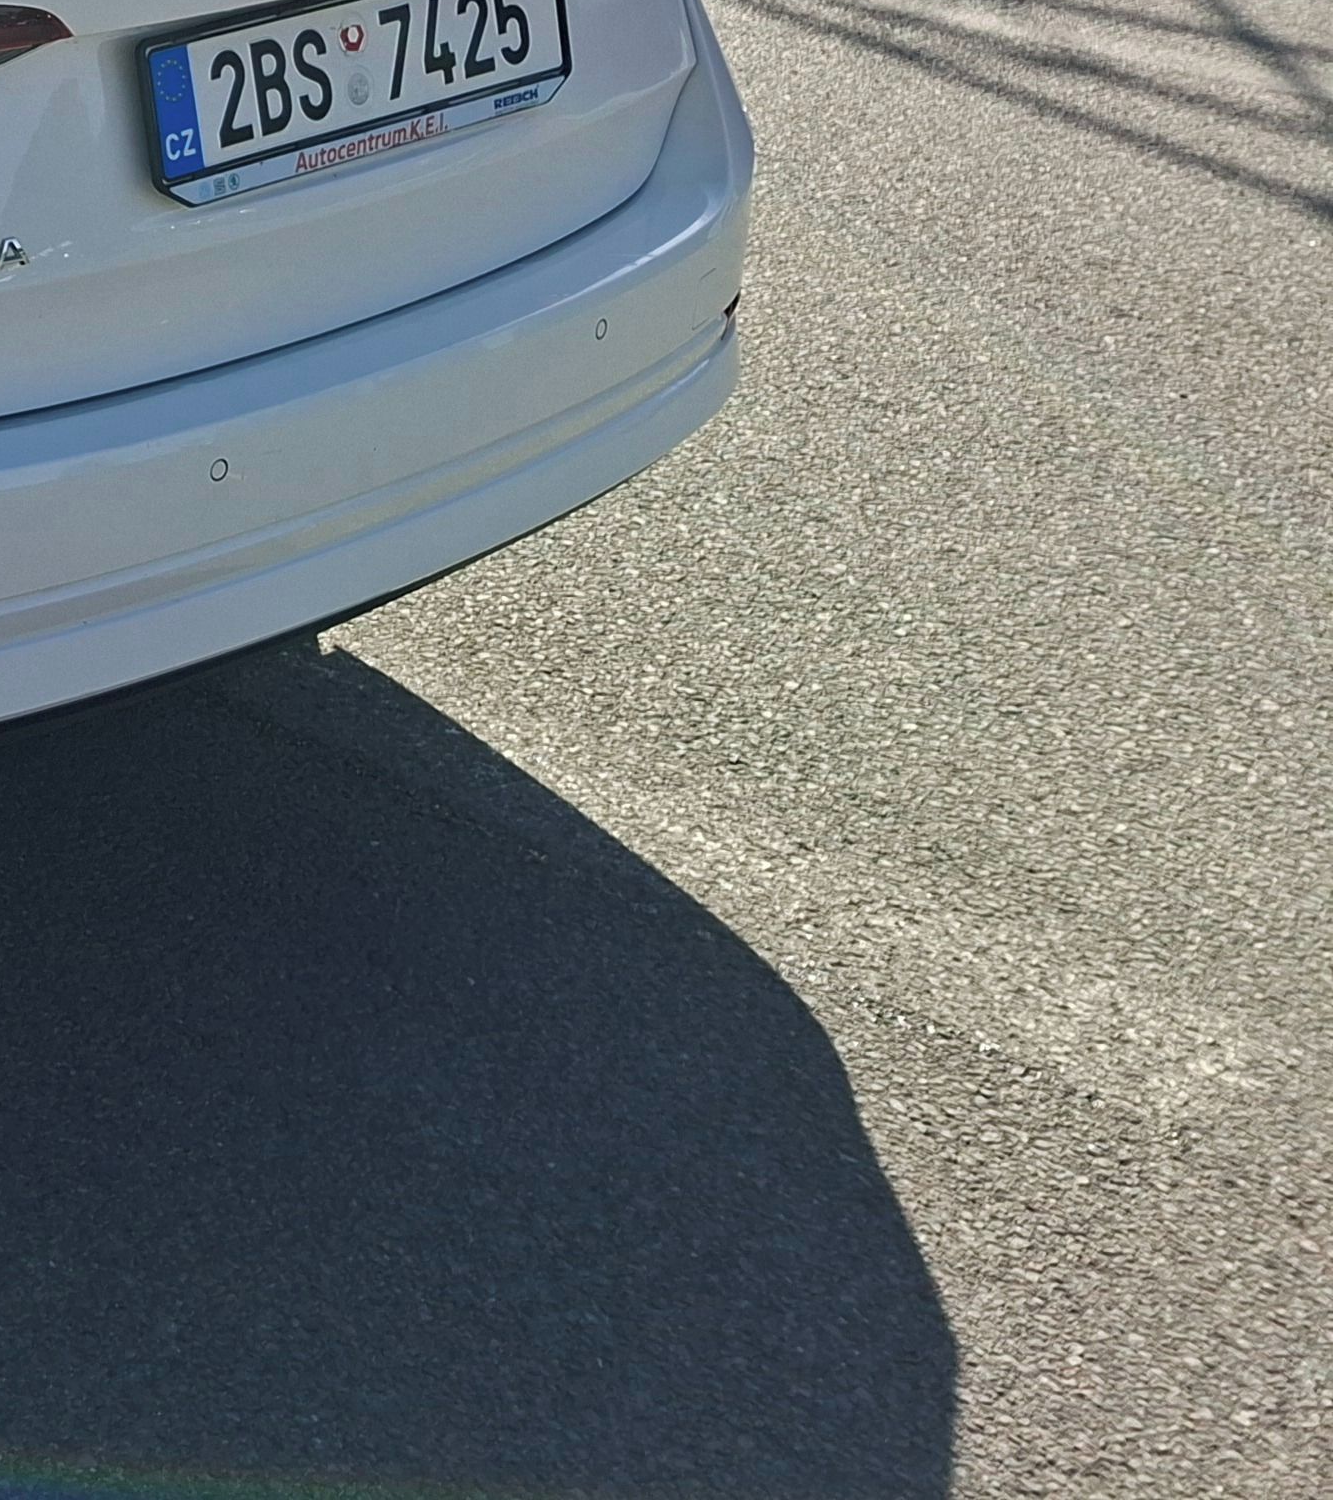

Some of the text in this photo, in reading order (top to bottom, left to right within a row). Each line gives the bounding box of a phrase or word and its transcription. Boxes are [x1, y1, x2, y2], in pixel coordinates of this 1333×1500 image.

[209, 28, 333, 149] 2BS
[165, 128, 196, 161] CZ
[294, 126, 408, 173] Autocentrum
